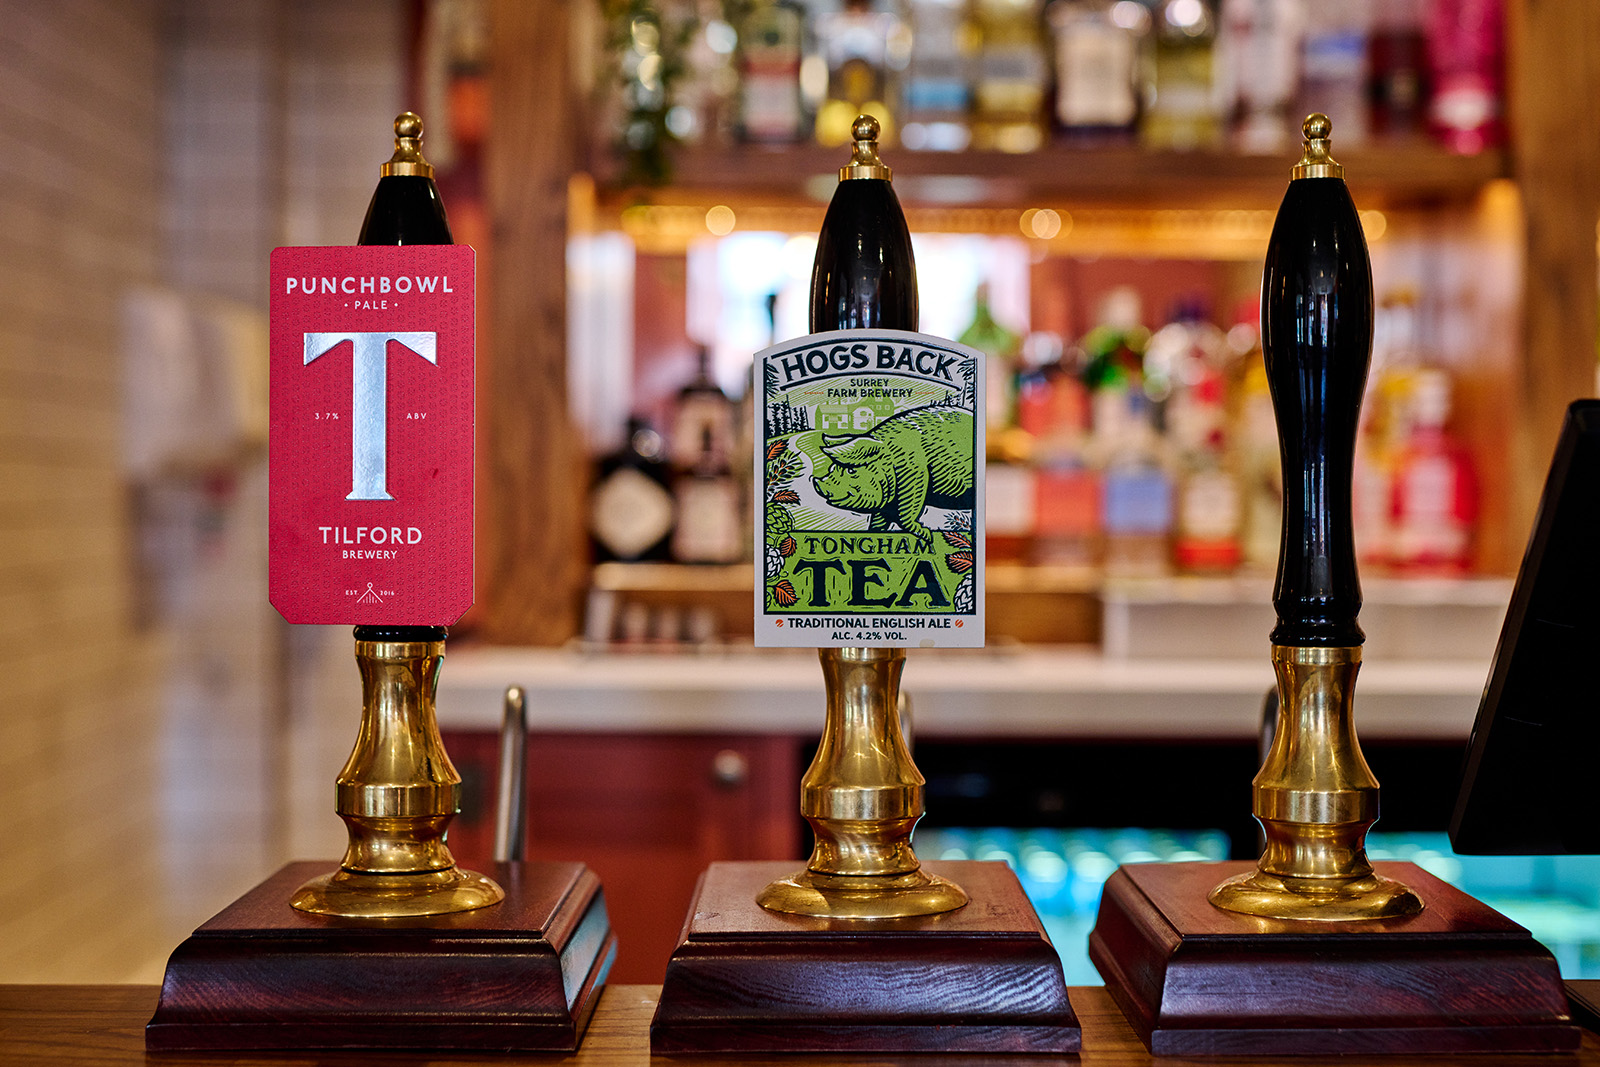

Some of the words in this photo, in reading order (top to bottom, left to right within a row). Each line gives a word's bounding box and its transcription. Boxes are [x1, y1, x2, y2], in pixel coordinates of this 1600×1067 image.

[286, 276, 453, 294] PUNCHBOWL
[354, 300, 388, 310] PALE
[781, 344, 870, 382] HOGS
[876, 344, 959, 381] BACK
[850, 378, 889, 387] SURREY
[827, 388, 858, 398] FARM
[860, 388, 913, 398] BREWERY
[303, 331, 438, 501] T
[314, 412, 339, 420] 3.7%
[406, 412, 427, 420] ABV
[318, 526, 422, 545] TILFORD
[804, 536, 935, 555] TONGHAM
[342, 550, 398, 559] BREWERY
[792, 558, 951, 608] TEA
[787, 617, 870, 629] TRADITIONAL
[872, 617, 925, 629] ENGLISH
[927, 617, 951, 629] ALE
[831, 631, 854, 640] ALC.
[855, 631, 882, 640] 4.2%
[884, 631, 907, 640] VOL.
